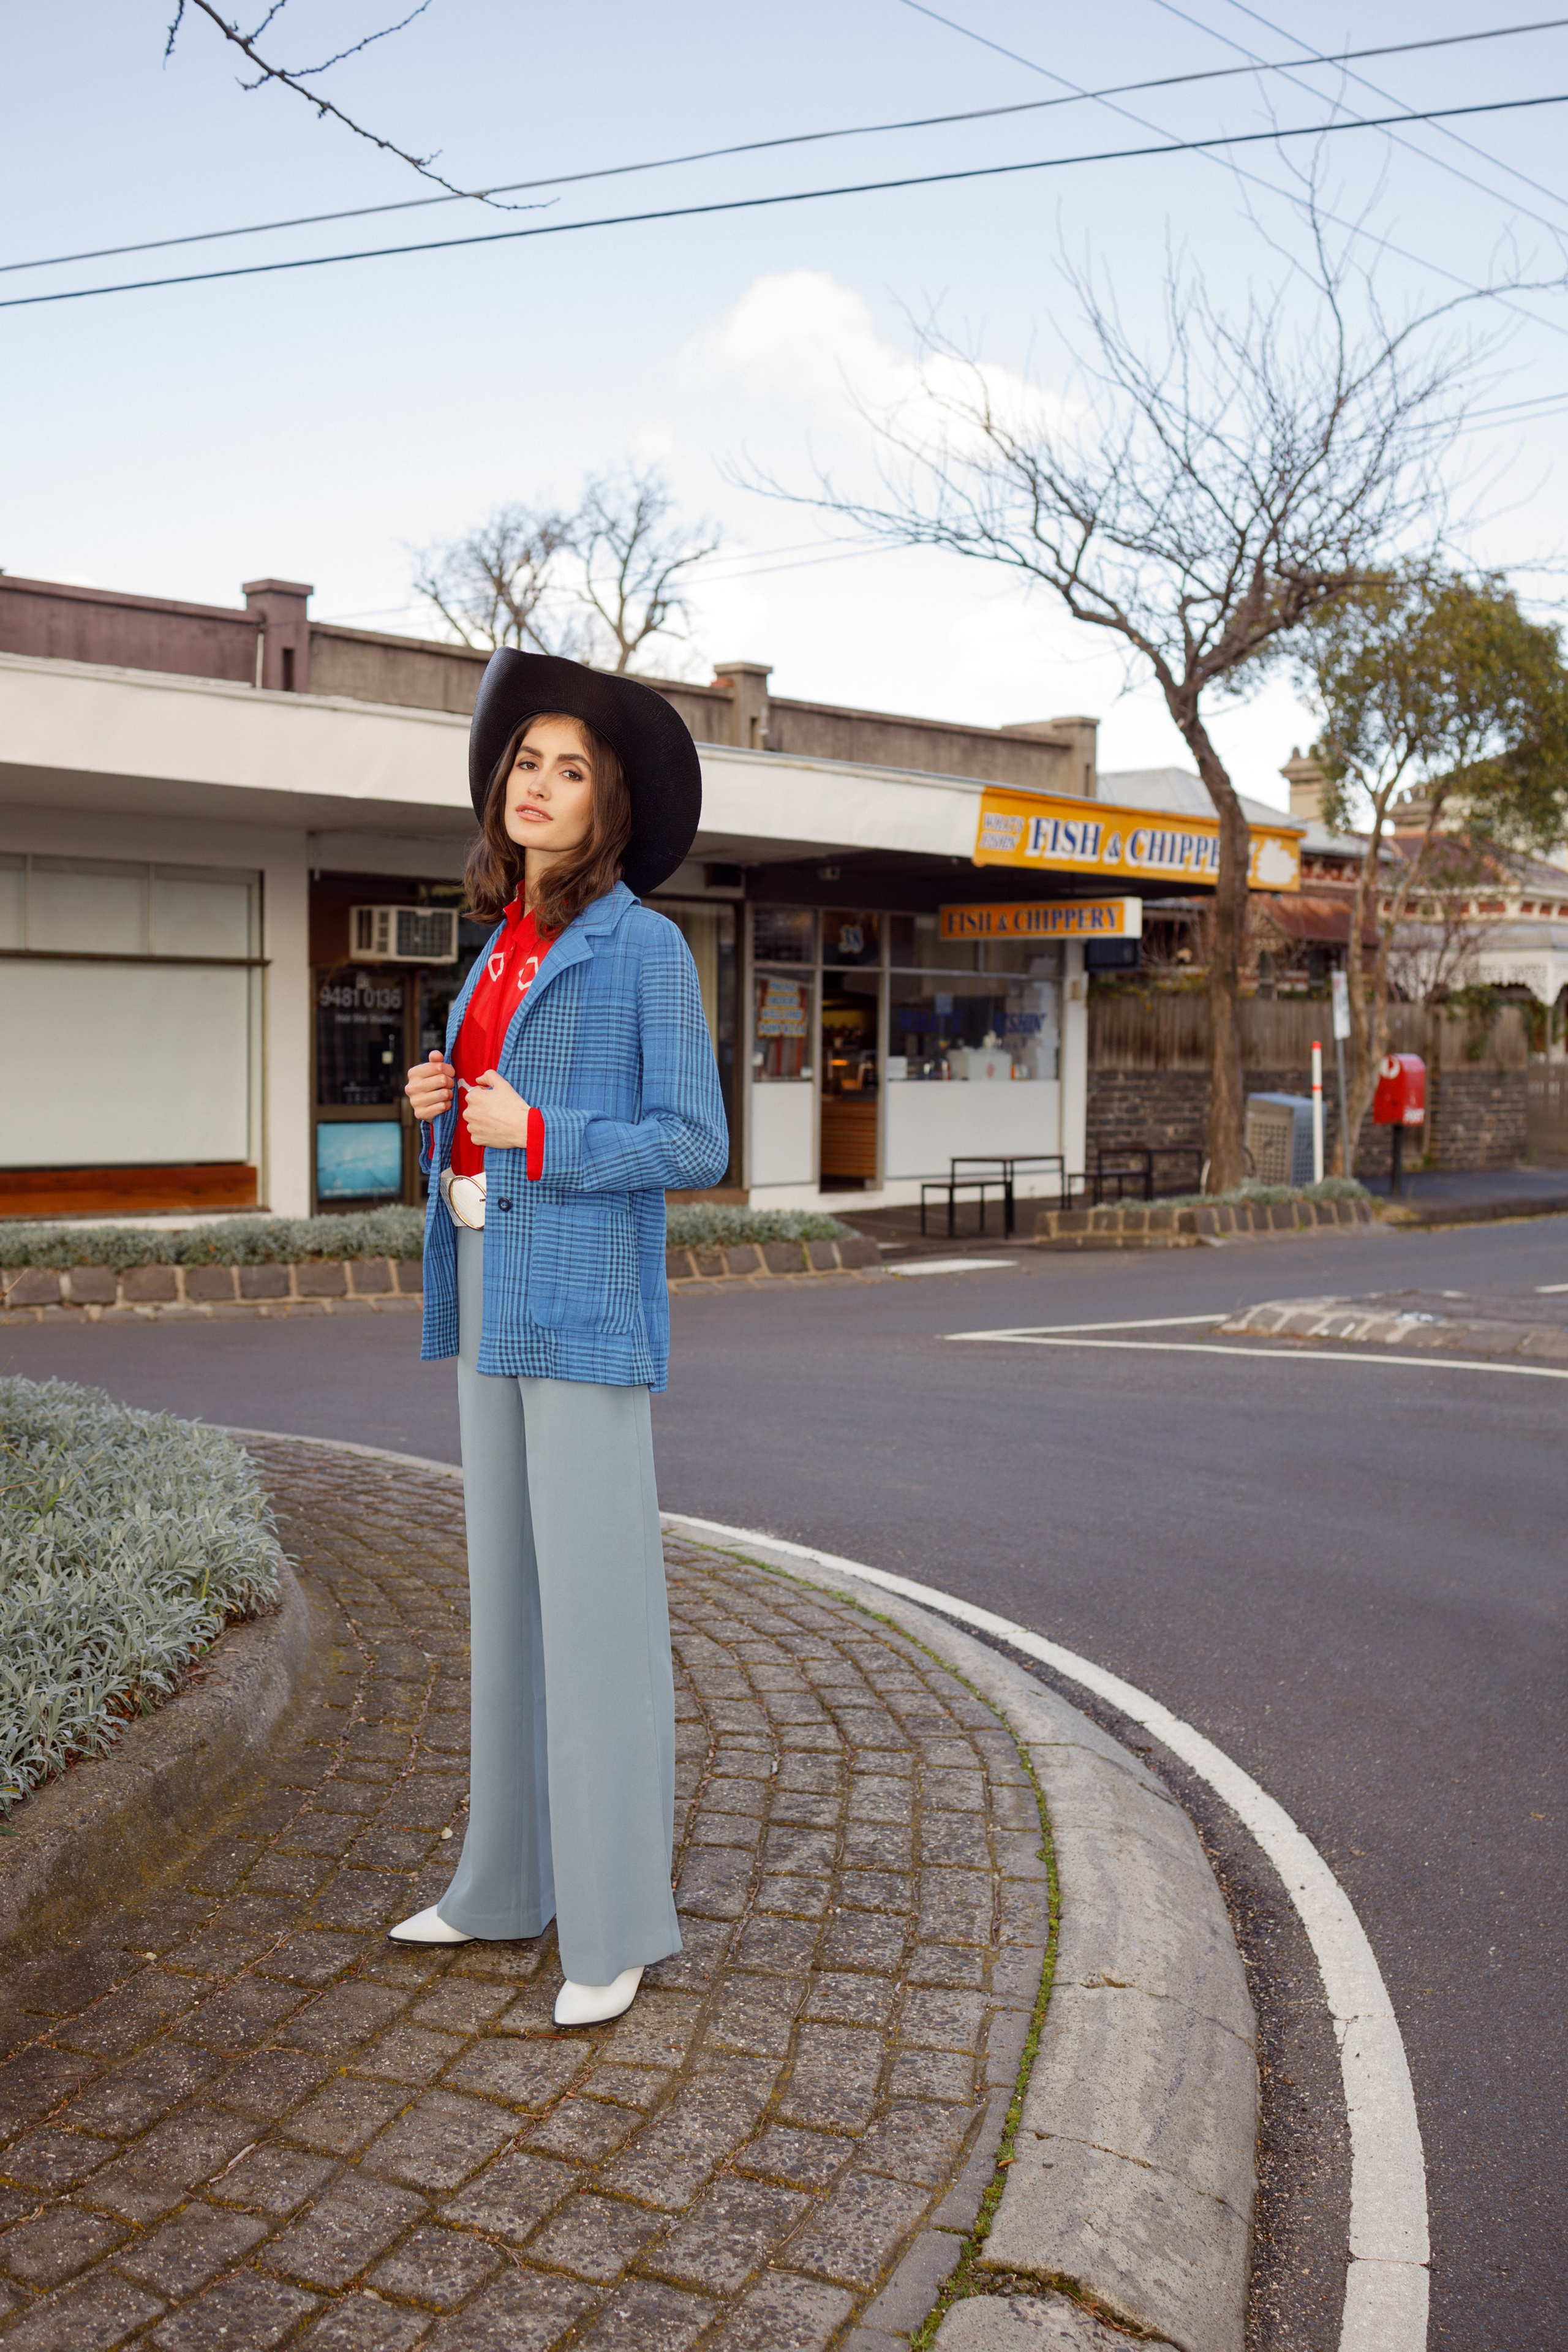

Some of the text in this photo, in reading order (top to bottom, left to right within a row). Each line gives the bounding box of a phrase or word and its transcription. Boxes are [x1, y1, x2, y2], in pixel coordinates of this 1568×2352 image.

[1026, 817, 1104, 861] FISH
[1103, 832, 1123, 864] &
[948, 906, 1120, 933] FISH & CHIPPERY
[320, 986, 360, 1008] 9481
